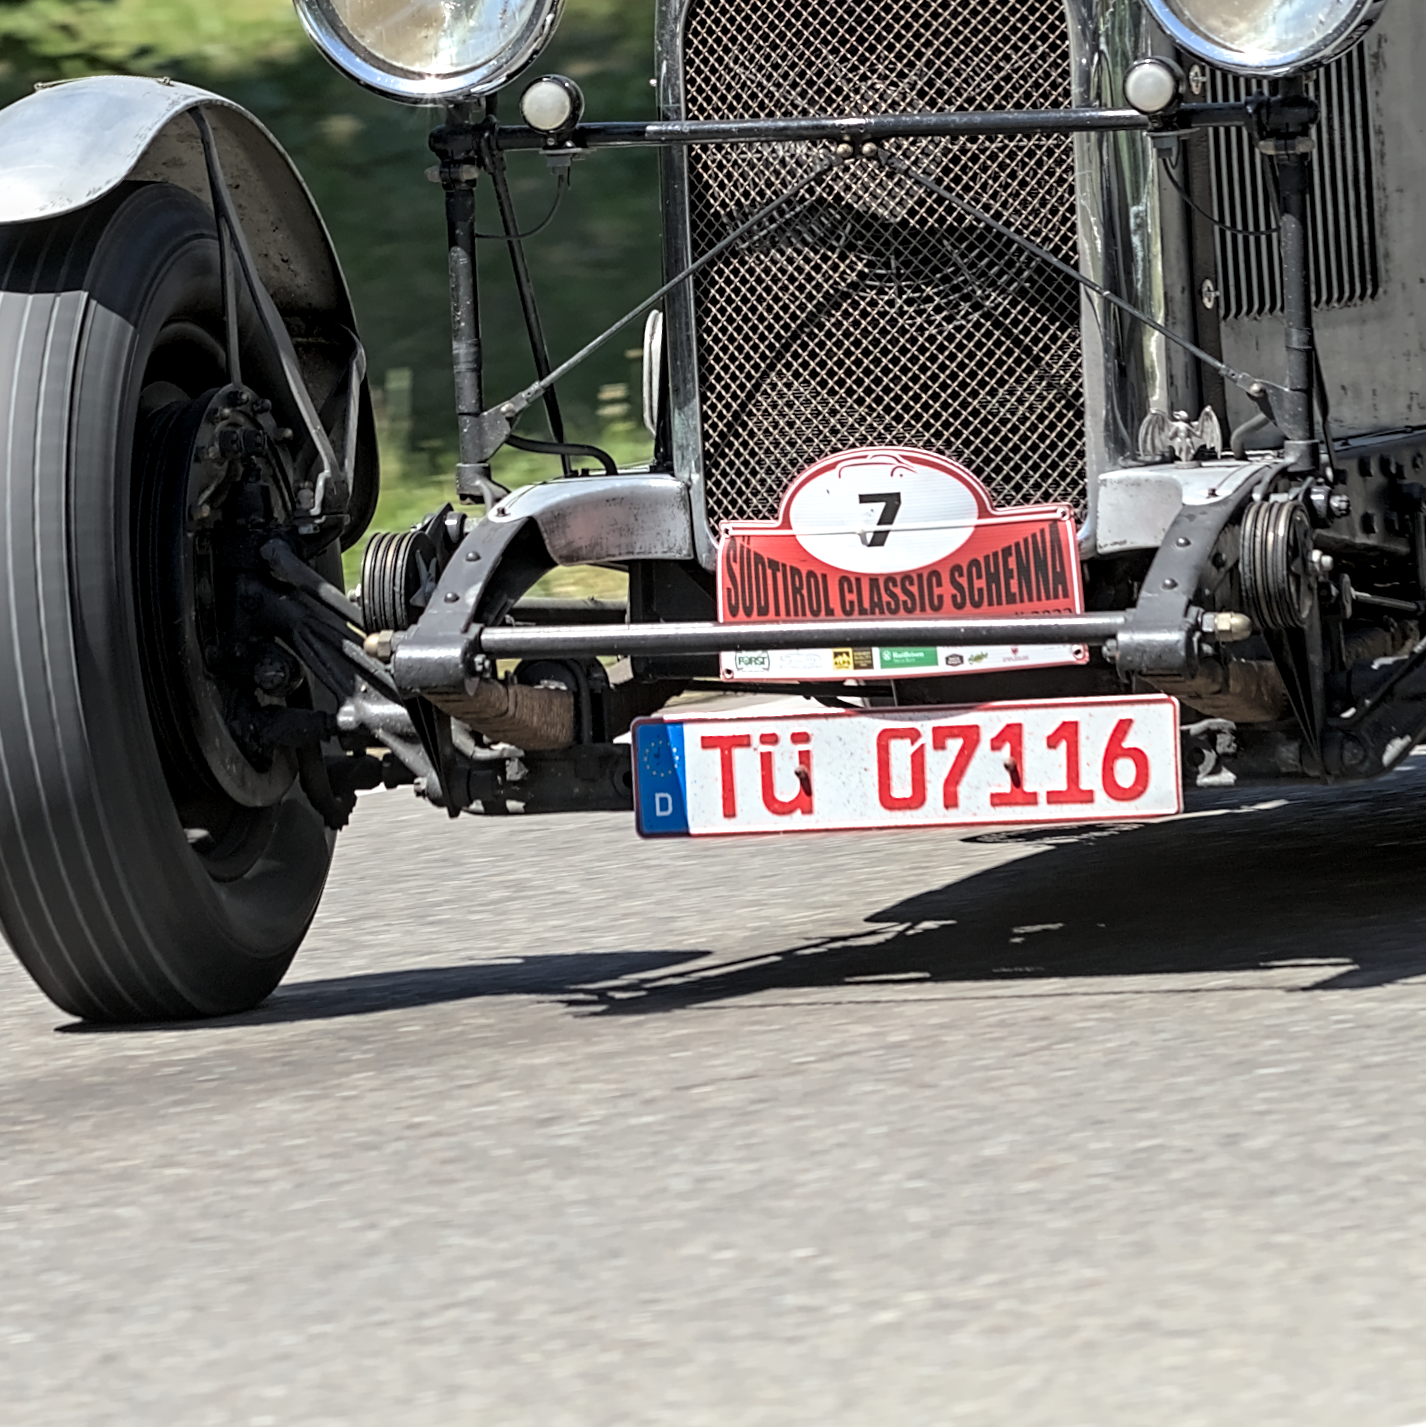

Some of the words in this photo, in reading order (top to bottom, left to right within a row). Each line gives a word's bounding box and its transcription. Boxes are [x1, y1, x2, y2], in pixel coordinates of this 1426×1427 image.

[858, 492, 902, 548] 7
[726, 535, 835, 618] SÜDTIROL
[838, 569, 944, 616] CLASSIC
[949, 521, 1070, 610] SCHENNA
[738, 657, 767, 666] FORST
[701, 731, 814, 819] Tü
[876, 718, 1151, 811] 07116
[655, 792, 673, 817] D
